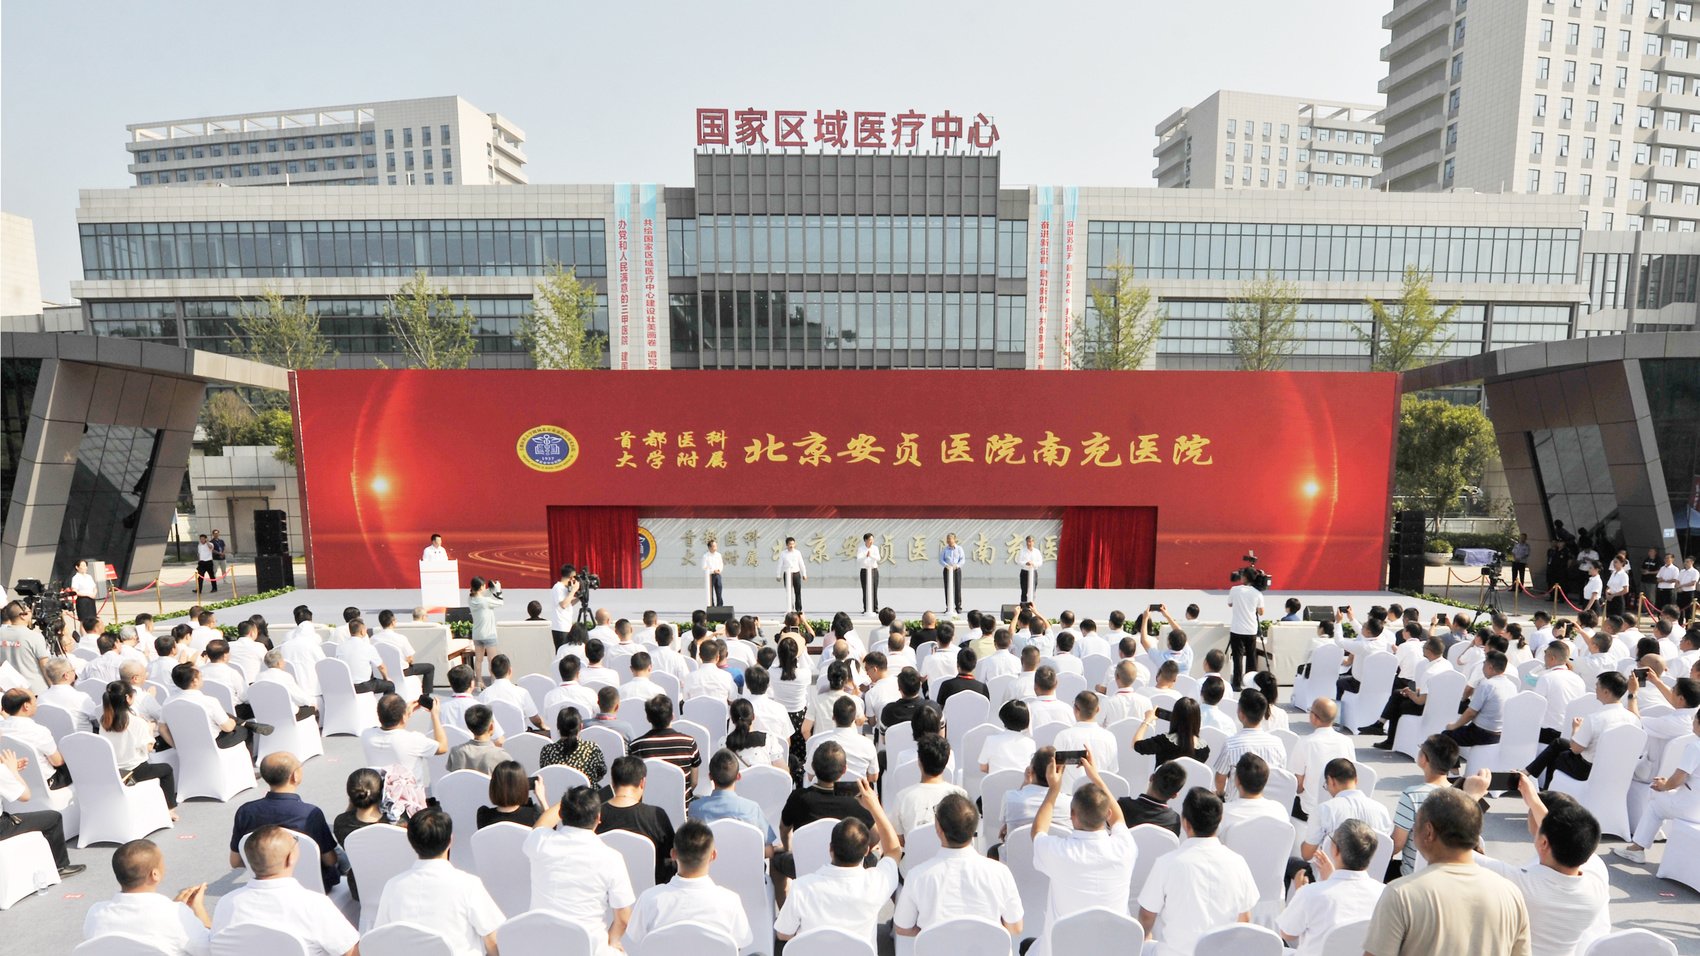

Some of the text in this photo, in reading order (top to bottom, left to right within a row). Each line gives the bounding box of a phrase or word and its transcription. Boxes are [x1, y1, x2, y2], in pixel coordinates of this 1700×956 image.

[696, 107, 1000, 149] 国家区域医疗中心
[614, 429, 728, 449] 首都医科
[744, 430, 1213, 468] 北京安贞医院南充医院
[615, 450, 728, 469] 大学附属
[681, 549, 760, 568] 大附属
